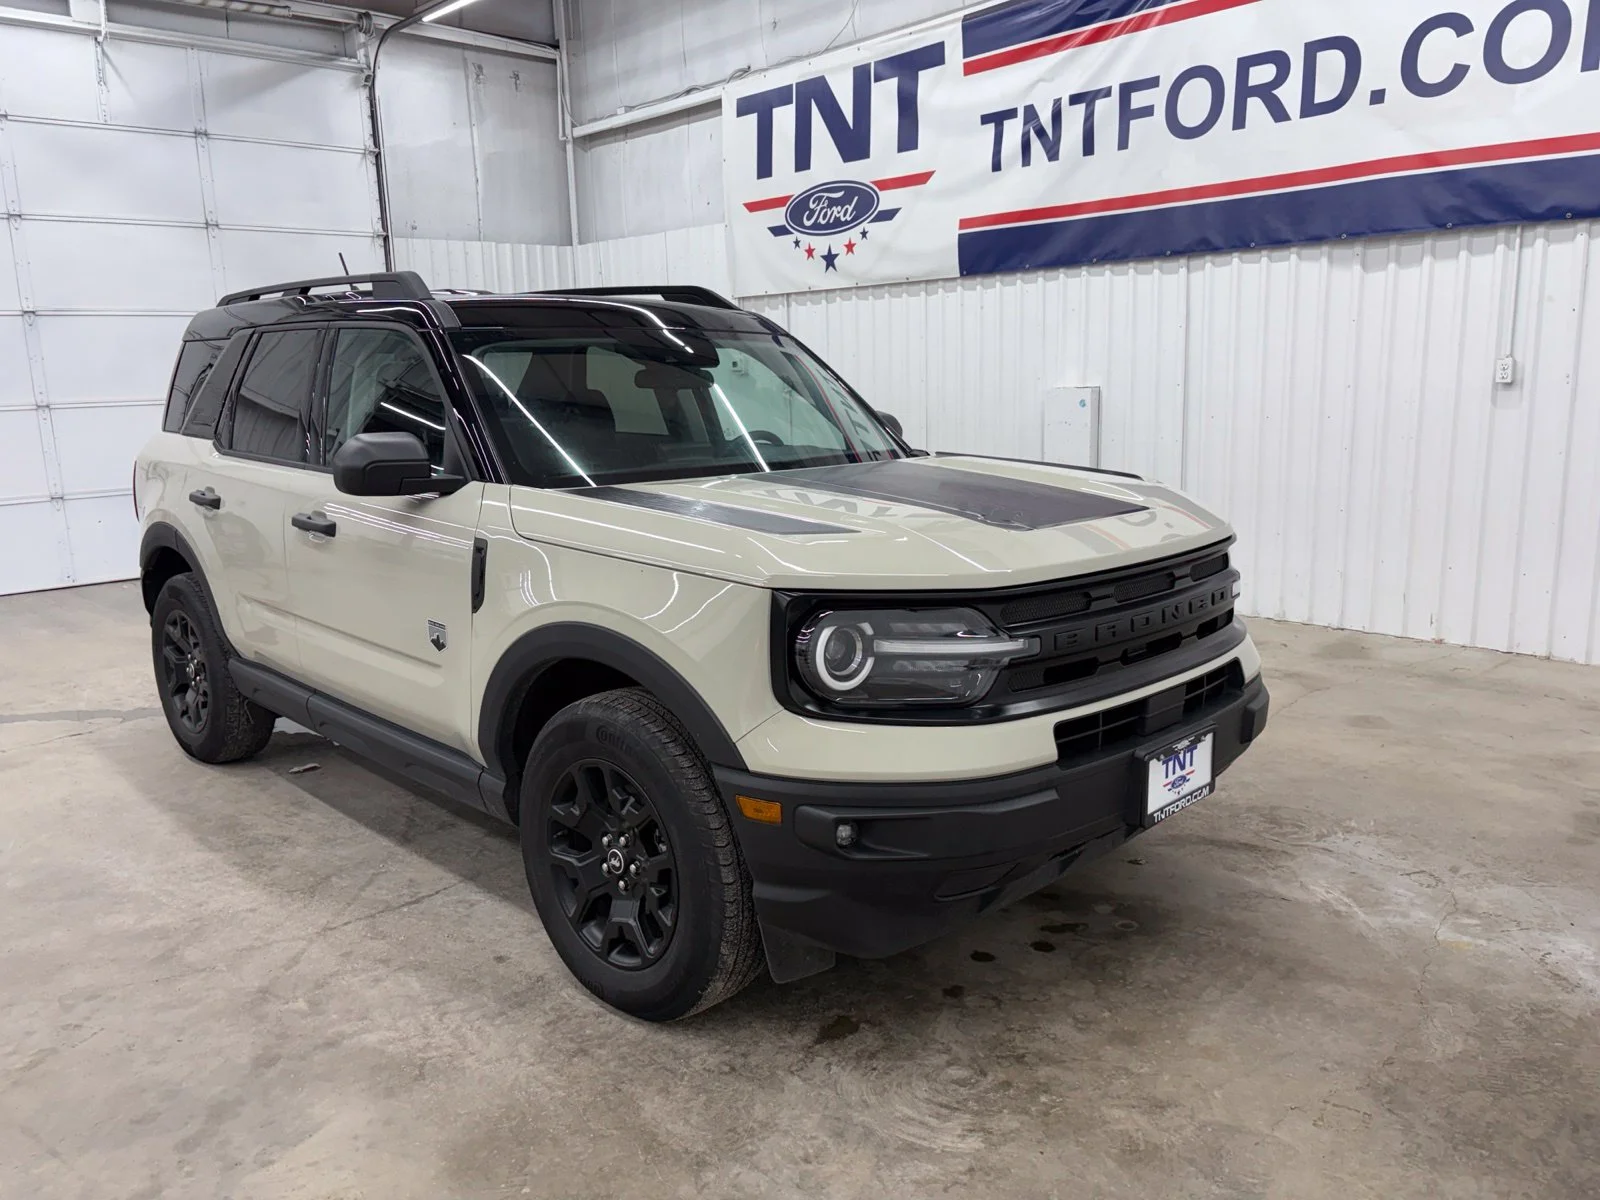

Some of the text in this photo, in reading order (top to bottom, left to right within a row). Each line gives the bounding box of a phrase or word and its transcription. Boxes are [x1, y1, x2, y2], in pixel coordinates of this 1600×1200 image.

[980, 0, 1600, 172] TNTFORD.CO
[736, 40, 946, 180] TNT
[803, 190, 858, 227] Ford
[1162, 744, 1198, 779] TNT
[1153, 785, 1210, 823] TNTFORD.COM
